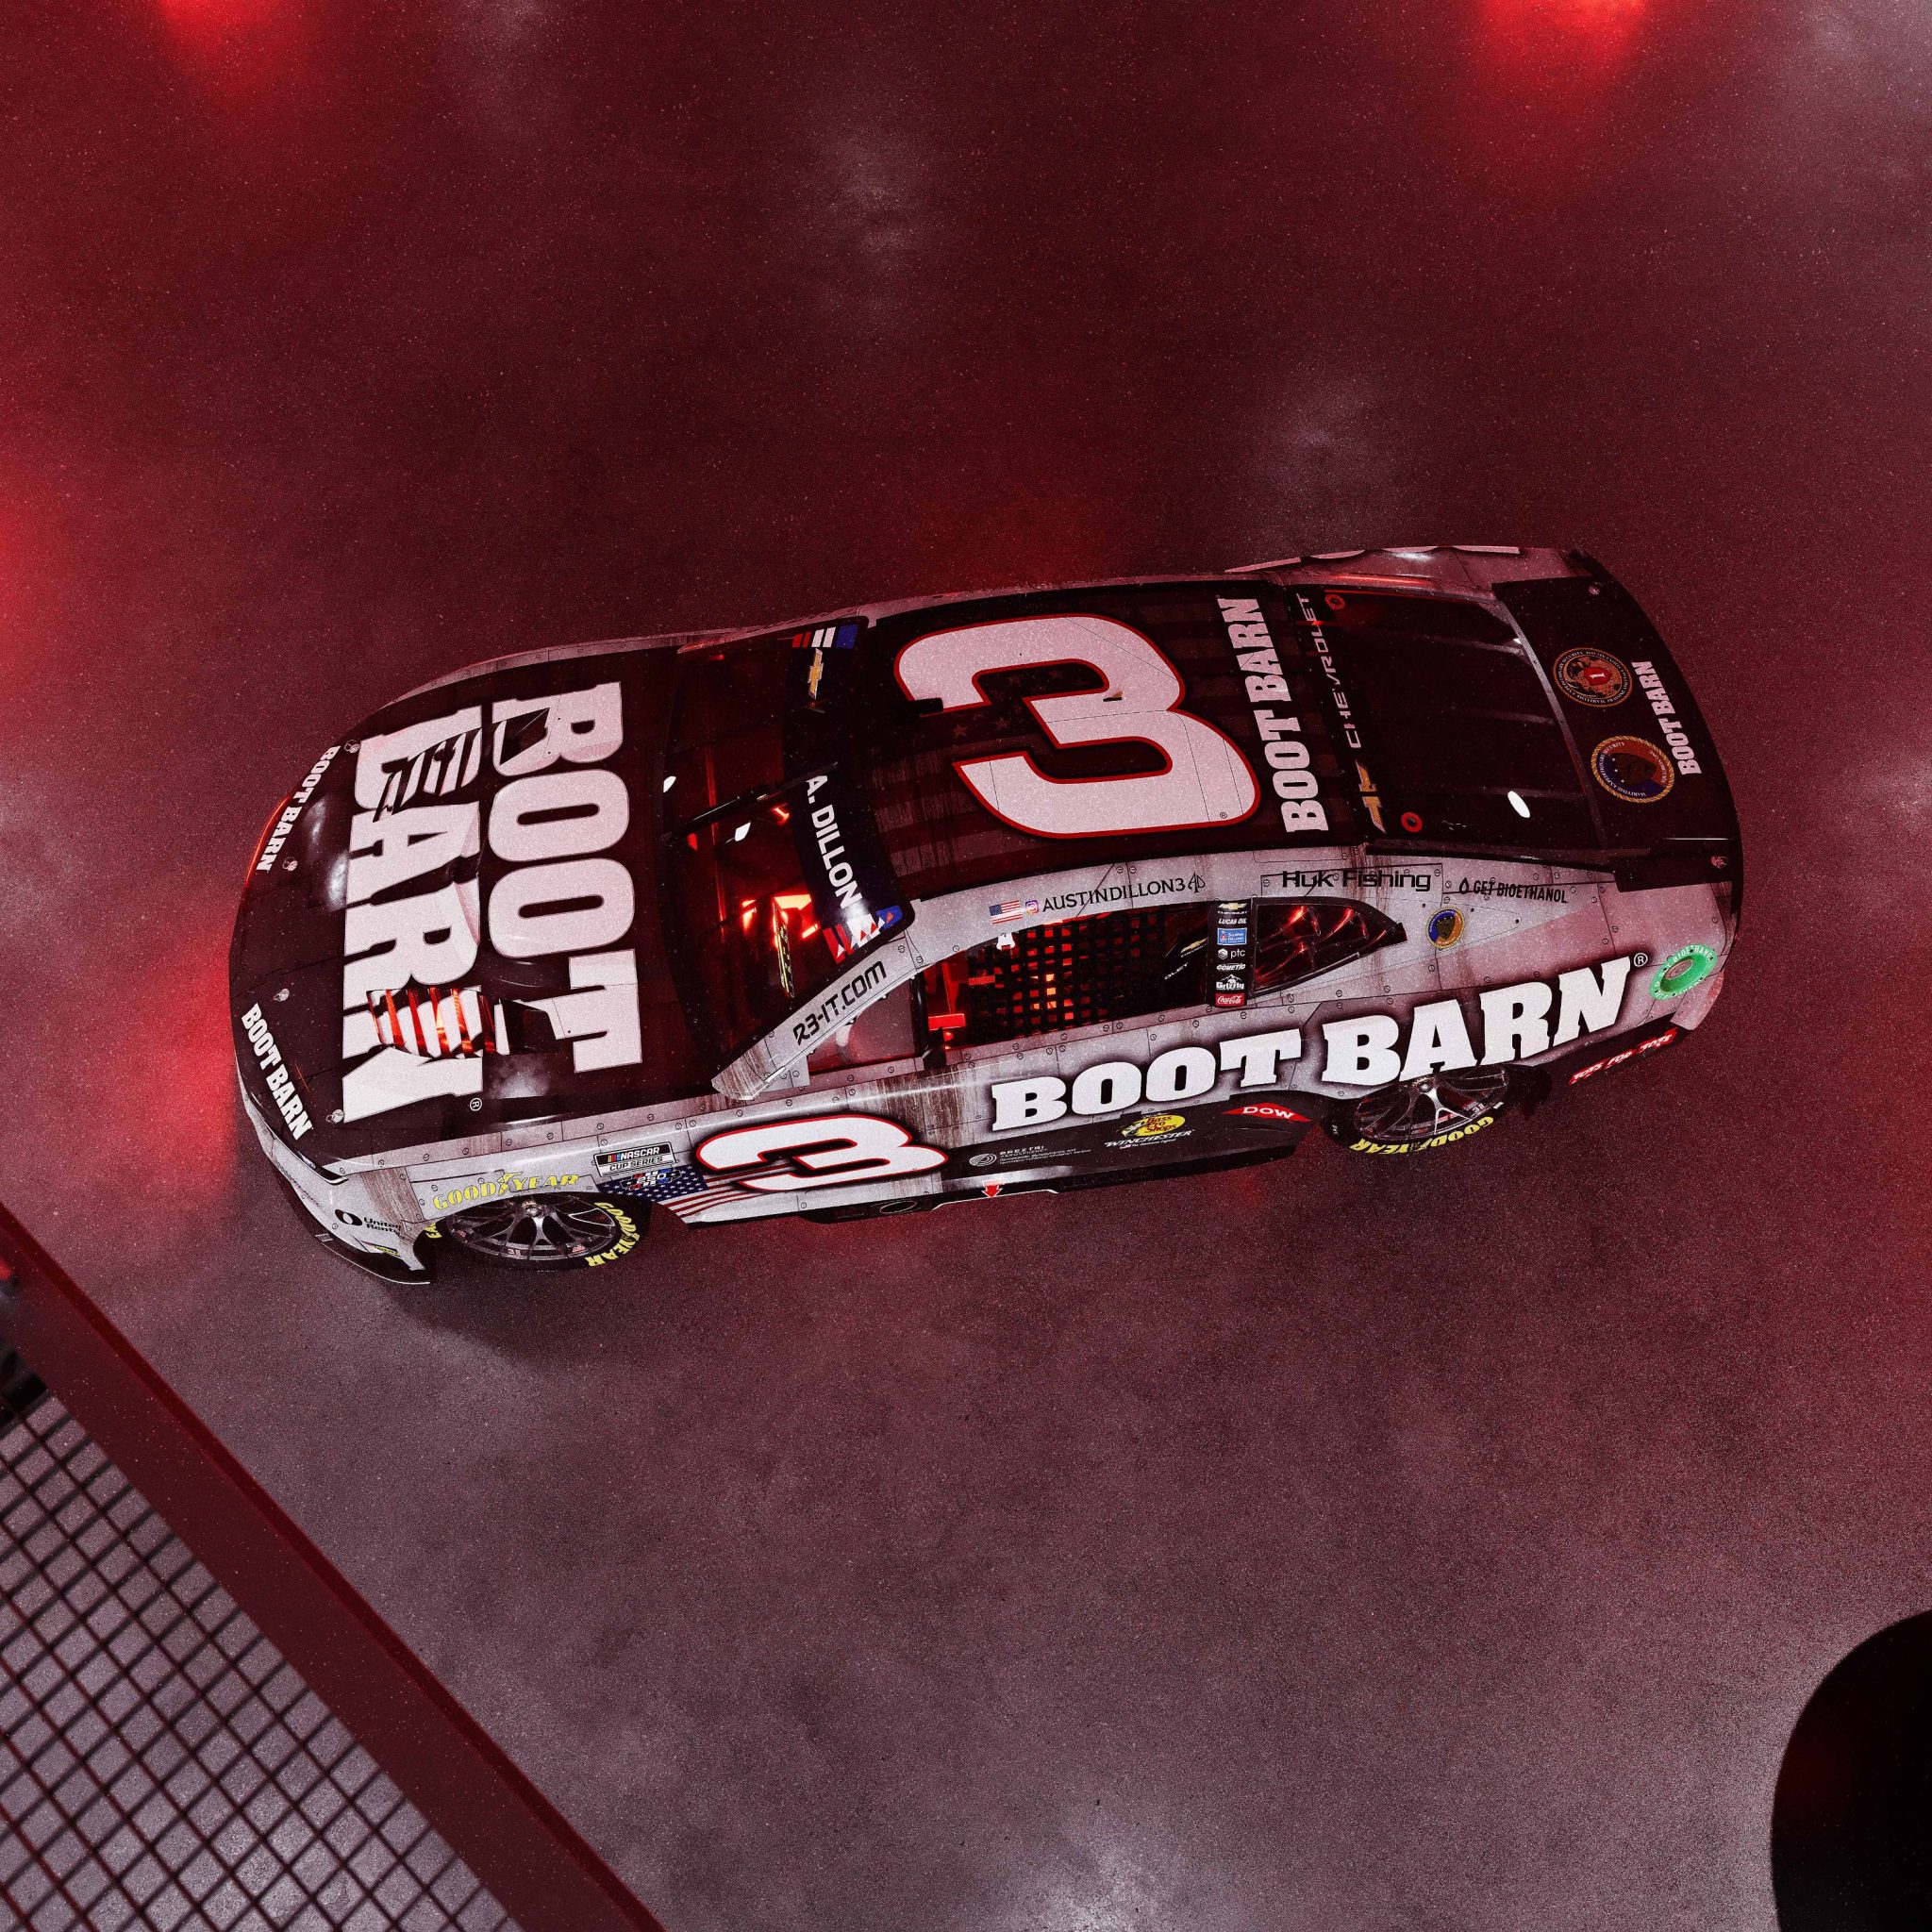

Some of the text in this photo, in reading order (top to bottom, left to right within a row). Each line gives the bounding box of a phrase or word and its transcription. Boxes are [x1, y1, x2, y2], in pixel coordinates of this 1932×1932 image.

[894, 612, 1261, 840] 3
[1217, 598, 1329, 833] BOOT BARN
[1631, 660, 1702, 775] BOOT BARN
[1602, 741, 1625, 756] SECURITY
[256, 745, 341, 872] BOOT BARN
[806, 774, 863, 910] A. DILLON
[1342, 869, 1432, 892] Fishing
[1474, 879, 1569, 904] GET BIOETHANOL
[342, 681, 643, 1124] BOOT BARN
[1230, 948, 1246, 958] ptc
[1216, 981, 1244, 991] Grizzly
[793, 960, 888, 1046] R3-IT.COM
[991, 956, 1631, 1131] BOOT BARN
[242, 1002, 282, 1071] BOOT
[265, 1063, 313, 1141] BARN
[1146, 1115, 1173, 1124] Bass
[1242, 1106, 1295, 1120] DOW
[1104, 1130, 1193, 1148] WINCHESTER
[1144, 1124, 1177, 1134] Shops
[609, 1157, 663, 1172] CUP SERIES
[620, 1146, 660, 1160] NASCAR
[695, 1113, 949, 1192] 3
[432, 1172, 580, 1210] GOODYEAR
[364, 1217, 402, 1232] United
